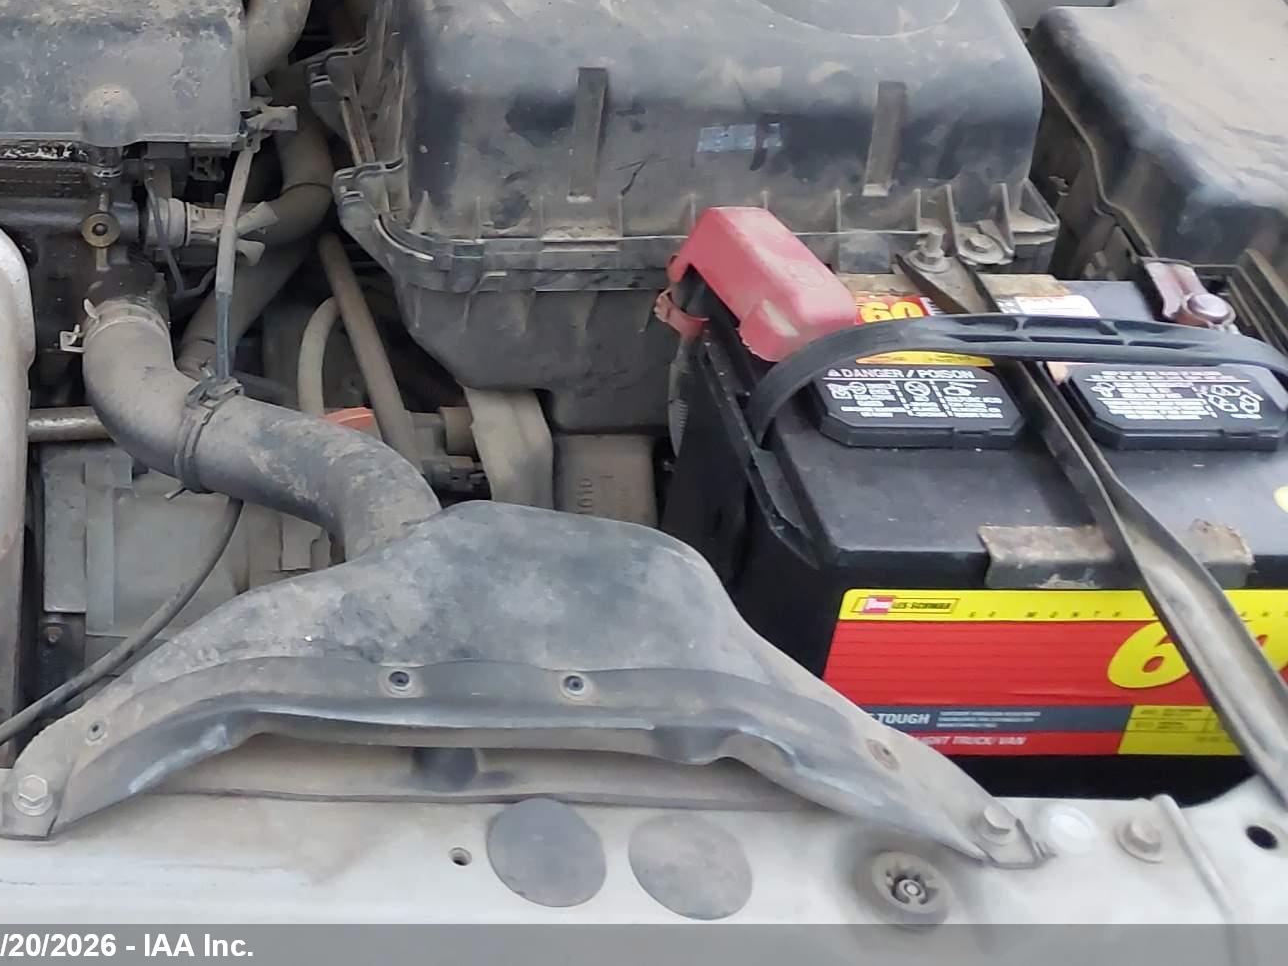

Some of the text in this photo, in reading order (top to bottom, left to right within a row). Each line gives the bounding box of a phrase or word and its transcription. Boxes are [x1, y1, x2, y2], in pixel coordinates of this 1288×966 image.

[841, 368, 905, 378] DANGER
[917, 369, 976, 379] POISON
[877, 713, 931, 725] TOUGH
